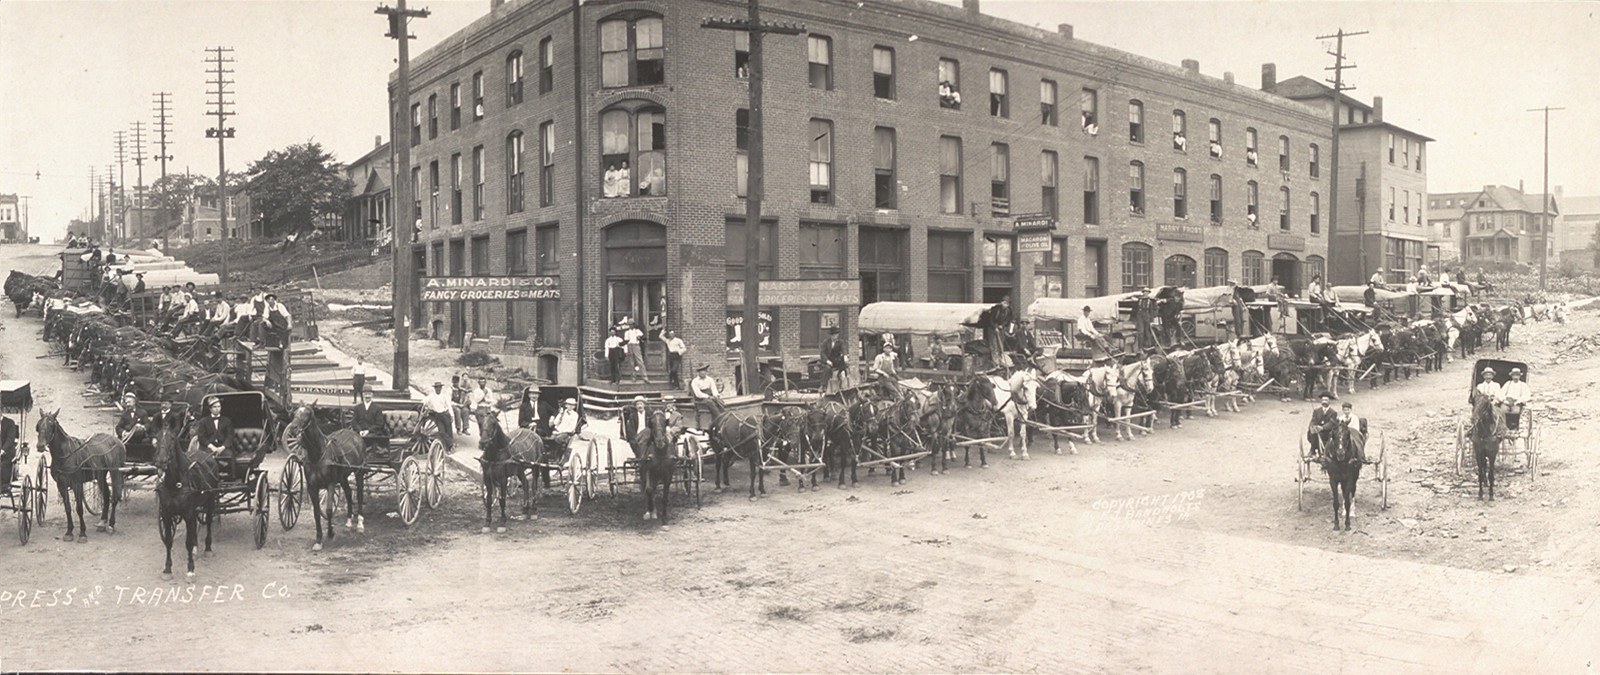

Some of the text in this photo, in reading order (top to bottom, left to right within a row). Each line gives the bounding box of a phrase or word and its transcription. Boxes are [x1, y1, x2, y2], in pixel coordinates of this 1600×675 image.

[760, 282, 800, 290] NARDI
[423, 290, 458, 300] FANCY
[460, 289, 520, 300] GROCERIES
[528, 289, 560, 299] MEATS
[825, 293, 859, 304] MEATS
